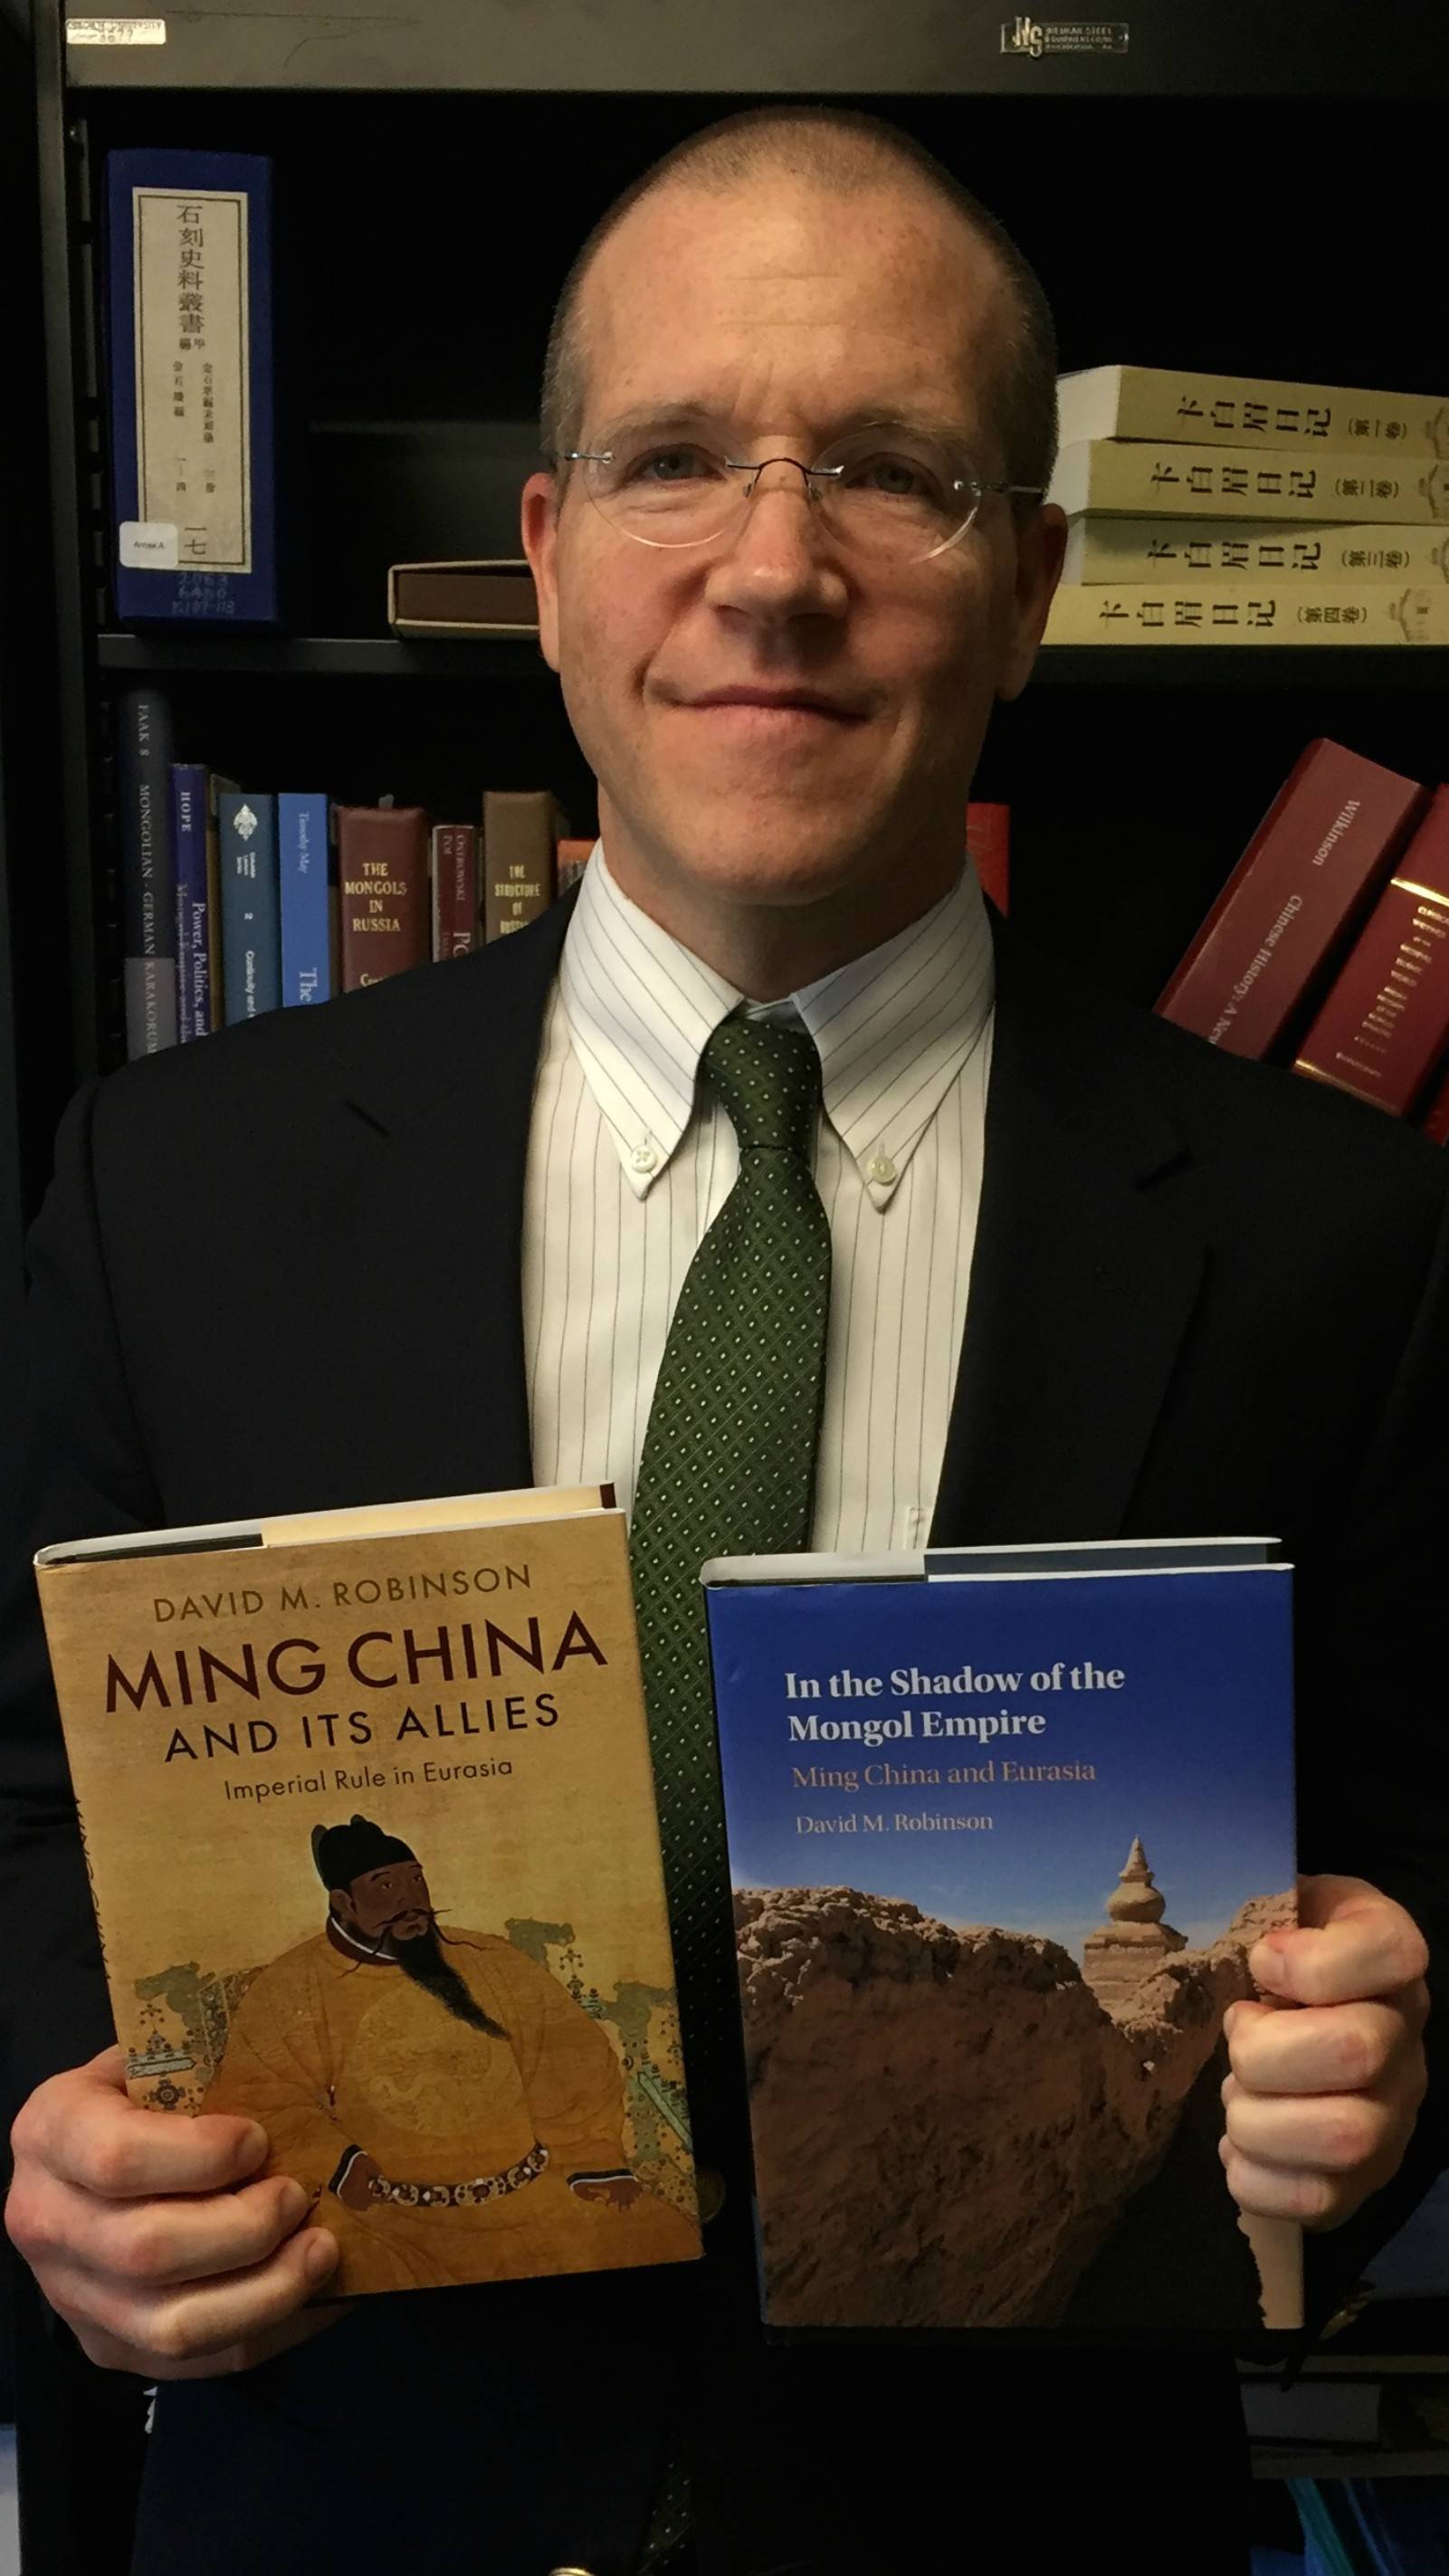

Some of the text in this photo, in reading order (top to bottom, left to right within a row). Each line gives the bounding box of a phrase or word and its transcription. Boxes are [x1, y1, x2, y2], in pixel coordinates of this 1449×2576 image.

[181, 791, 192, 832] HOPE
[1312, 799, 1360, 866] Wilkinson
[345, 881, 407, 895] MONGOLS
[362, 863, 388, 876] THE
[510, 865, 526, 879] THE
[369, 900, 383, 913] IN
[495, 883, 541, 897] STRUCTURE
[139, 785, 158, 1054] MONGOLIAN GERMAN KARAKORUM
[352, 918, 401, 932] RUSSIA
[1264, 894, 1303, 949] Chinese
[191, 902, 209, 1036] Power, Politics, and
[300, 967, 318, 1003] The
[154, 1564, 532, 1623] DAVID M. ROBINSON
[105, 1610, 608, 1713] MING CHINA
[785, 1662, 1125, 1700] In the Shadow of the
[164, 1693, 559, 1762] AND ITS ALLIES
[788, 1709, 1046, 1748] Mongol Empire
[224, 1757, 513, 1802] Imperial Rule in Eurasia
[793, 1759, 1096, 1793] Ming China and Eurasia
[796, 1812, 994, 1835] David M. Robinson
